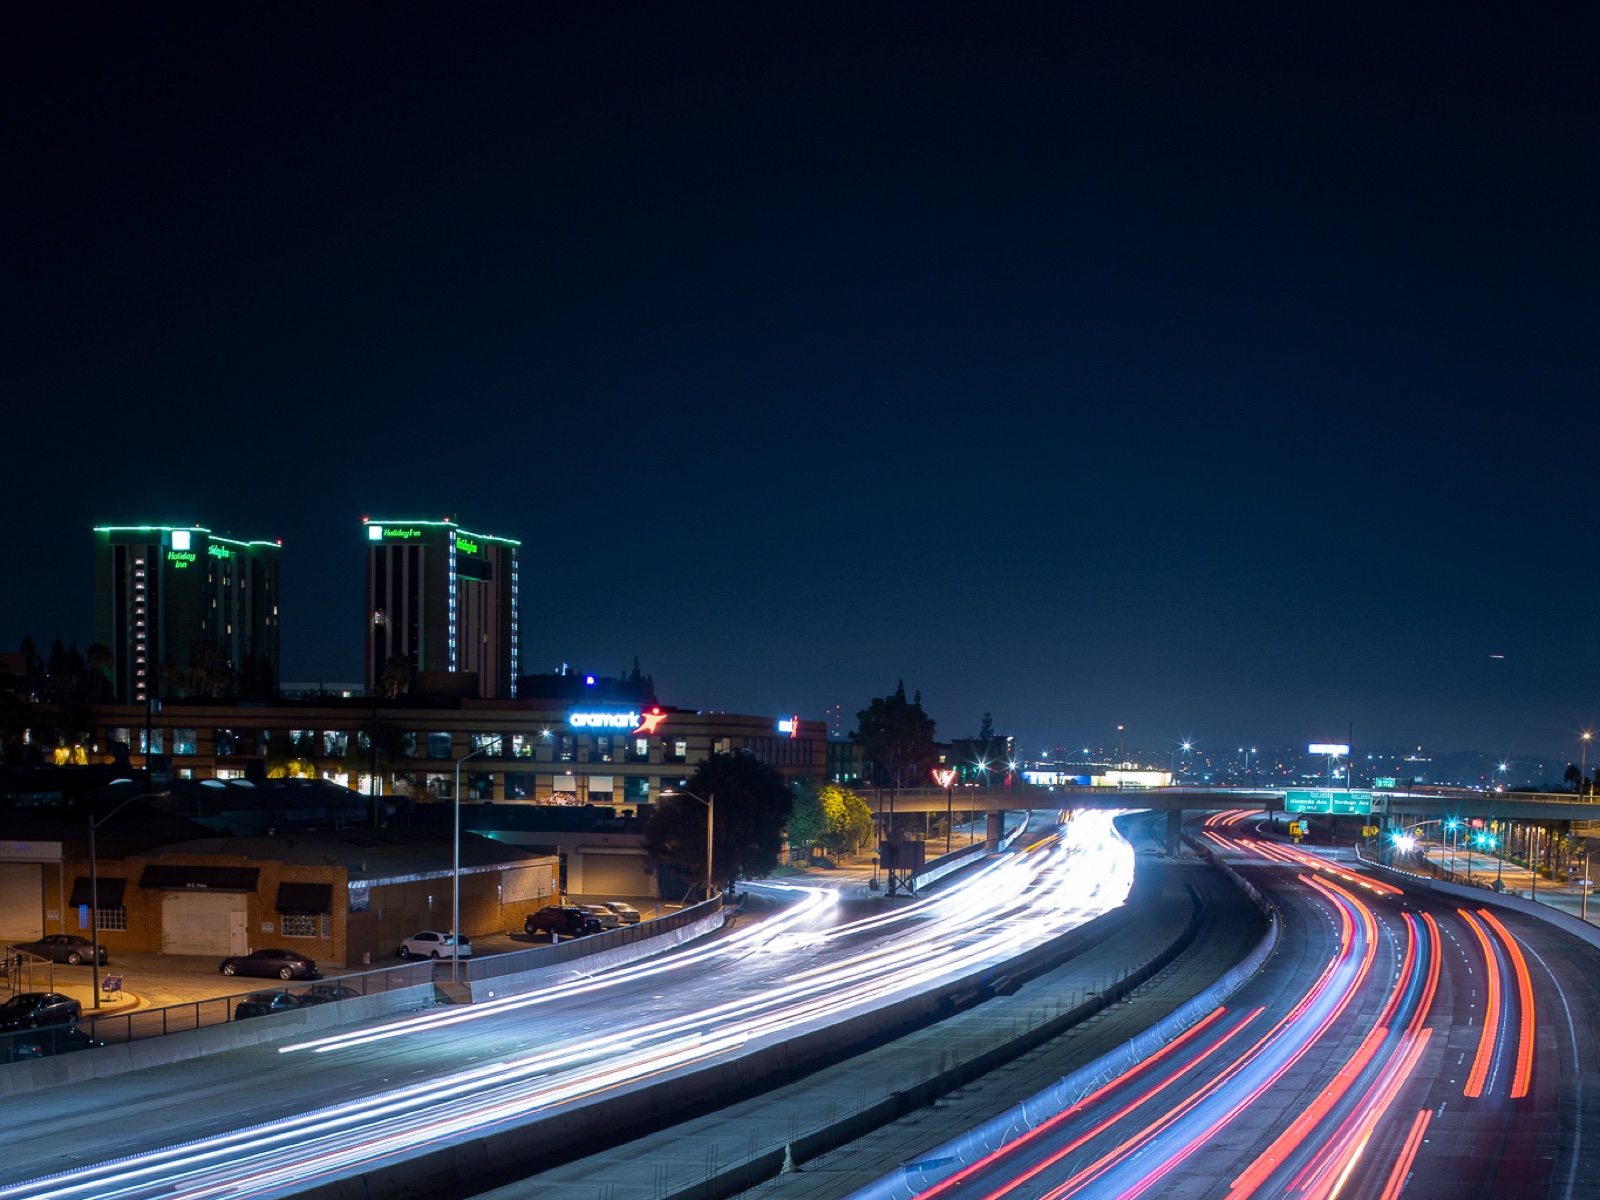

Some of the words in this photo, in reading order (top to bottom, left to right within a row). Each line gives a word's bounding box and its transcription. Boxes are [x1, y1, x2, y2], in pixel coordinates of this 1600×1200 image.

[383, 528, 409, 539] Holiday
[167, 552, 196, 562] Holiday
[175, 560, 187, 568] Inn
[570, 711, 640, 727] aramark
